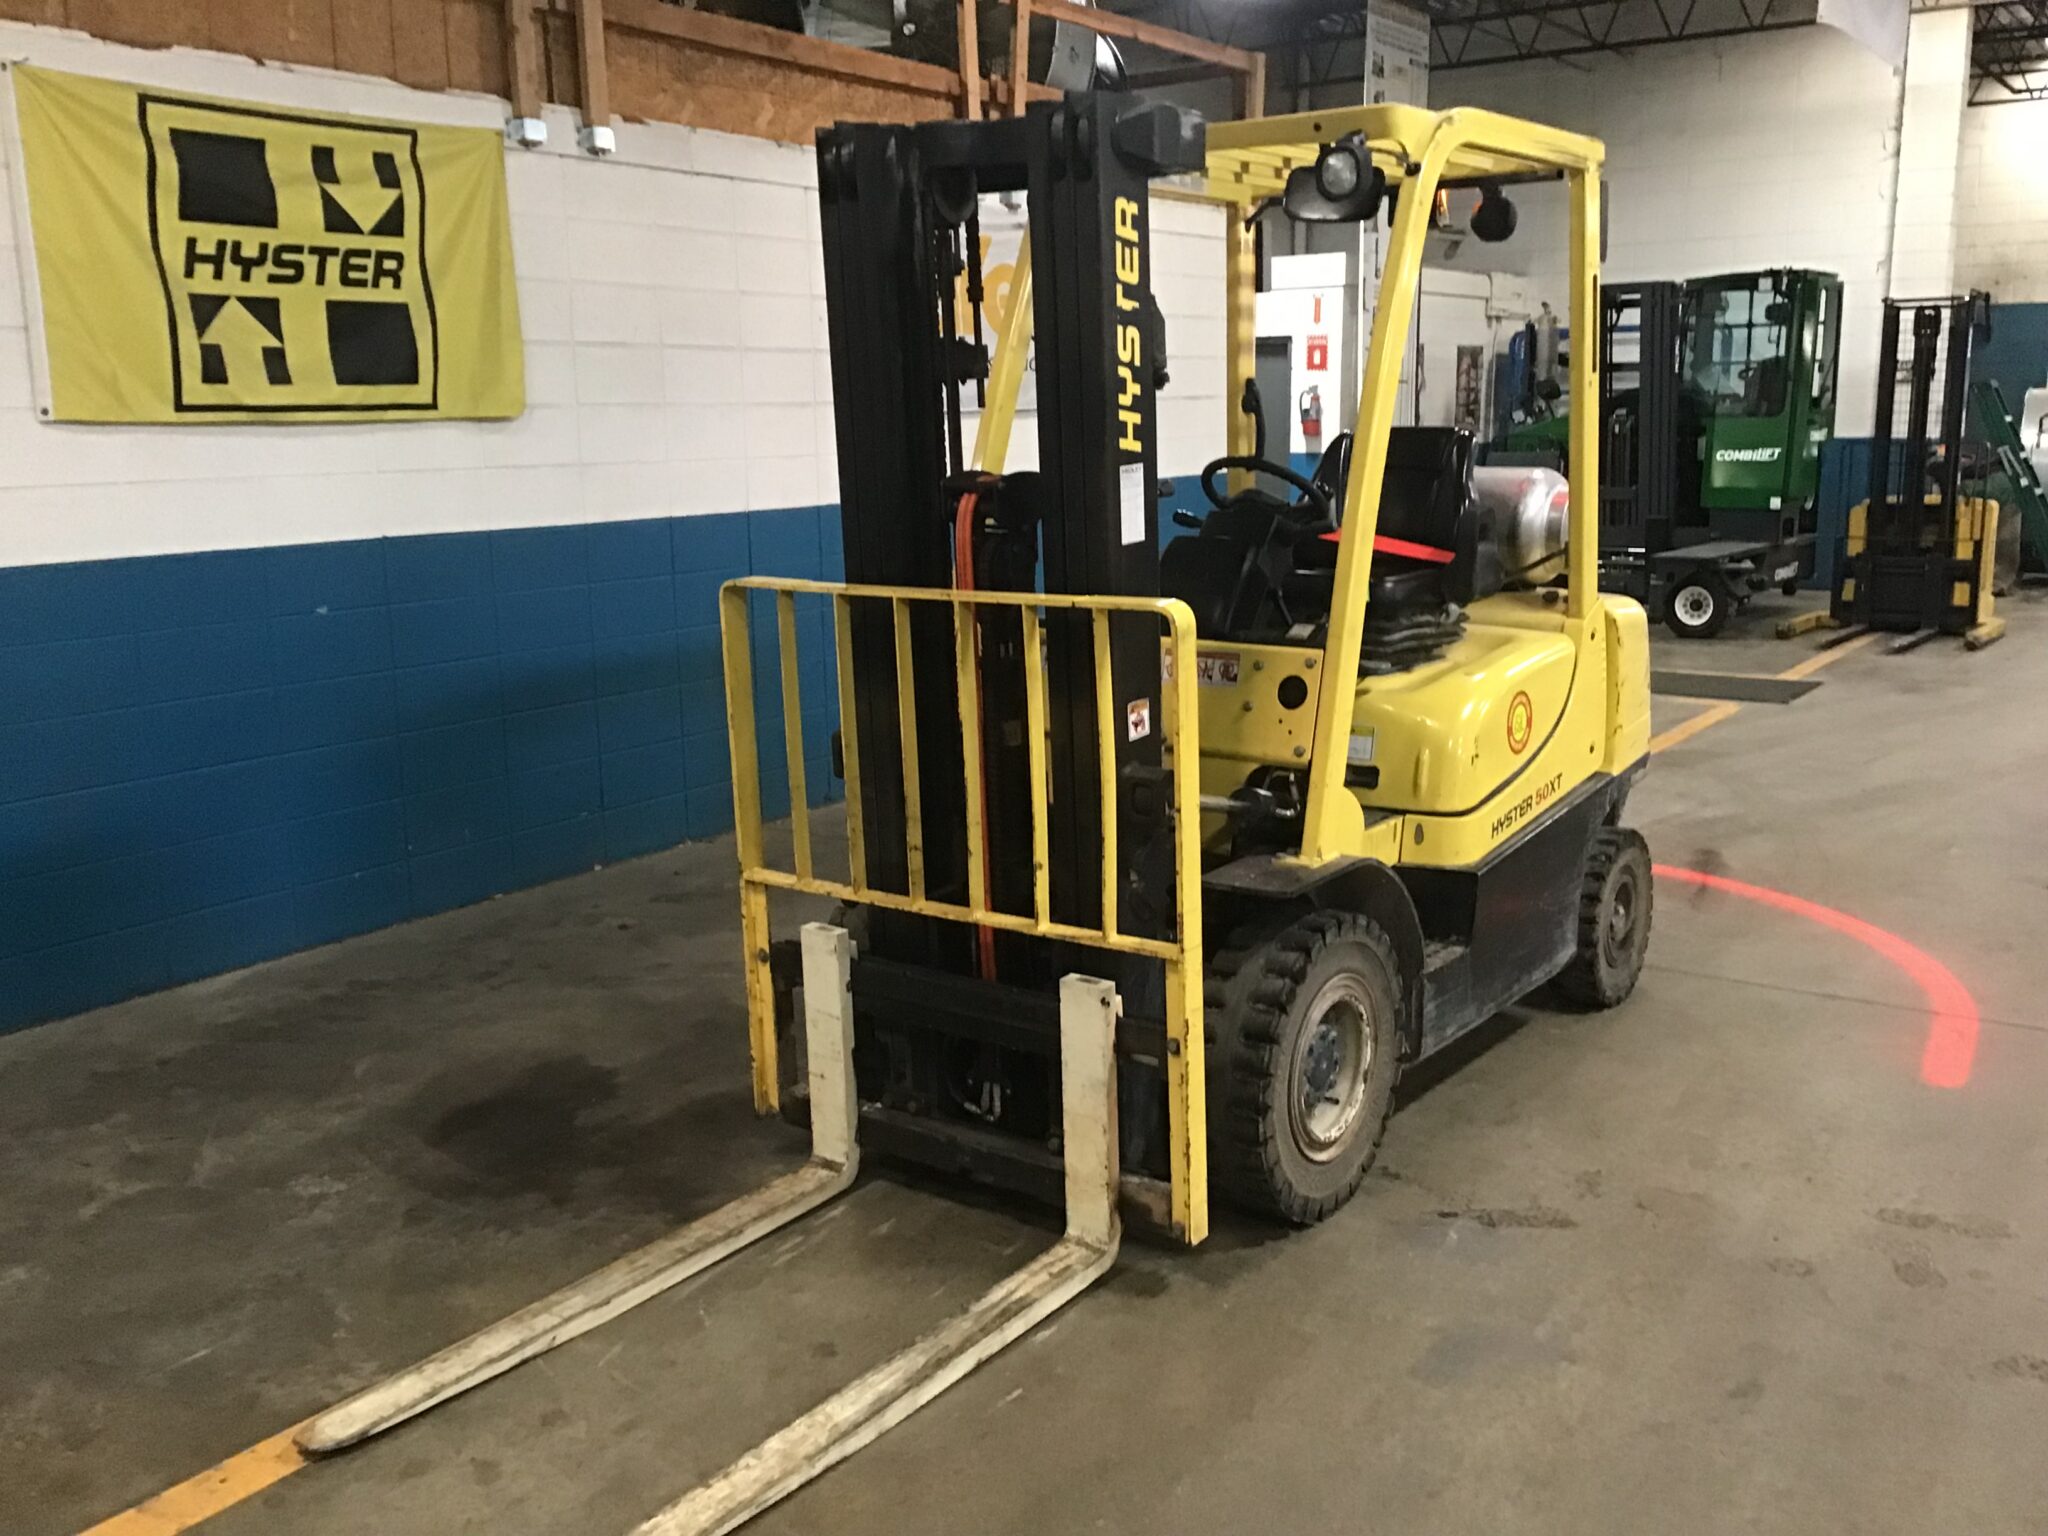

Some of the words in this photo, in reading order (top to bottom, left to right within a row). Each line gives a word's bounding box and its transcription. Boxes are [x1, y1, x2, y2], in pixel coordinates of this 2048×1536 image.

[184, 237, 404, 289] HYSTER
[1115, 196, 1142, 453] HYSTER
[1491, 795, 1533, 839] HYSTER
[1535, 773, 1563, 805] 50XT
